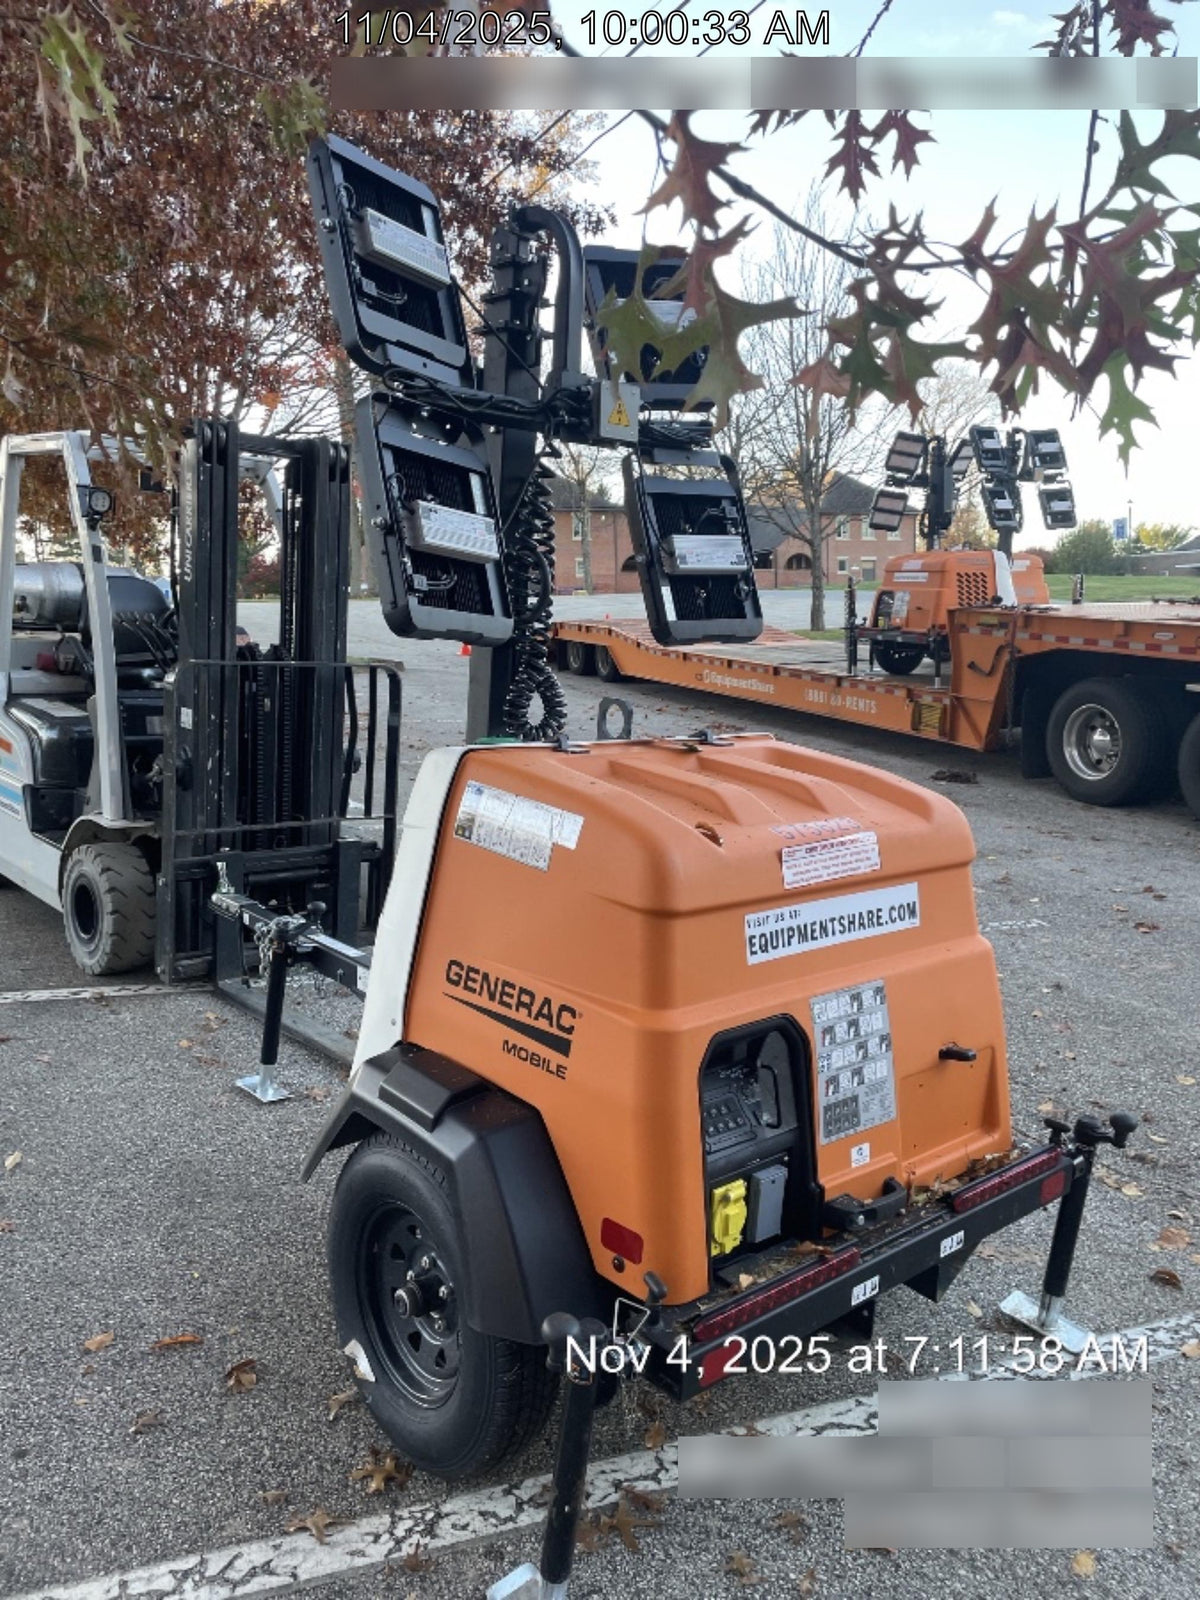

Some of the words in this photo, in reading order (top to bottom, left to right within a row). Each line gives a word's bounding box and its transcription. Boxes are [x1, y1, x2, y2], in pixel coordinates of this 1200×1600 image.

[748, 900, 918, 956] EQUIPMENTSHARE.COM
[445, 959, 577, 1035] GENERAC
[502, 1039, 568, 1080] MOBILE
